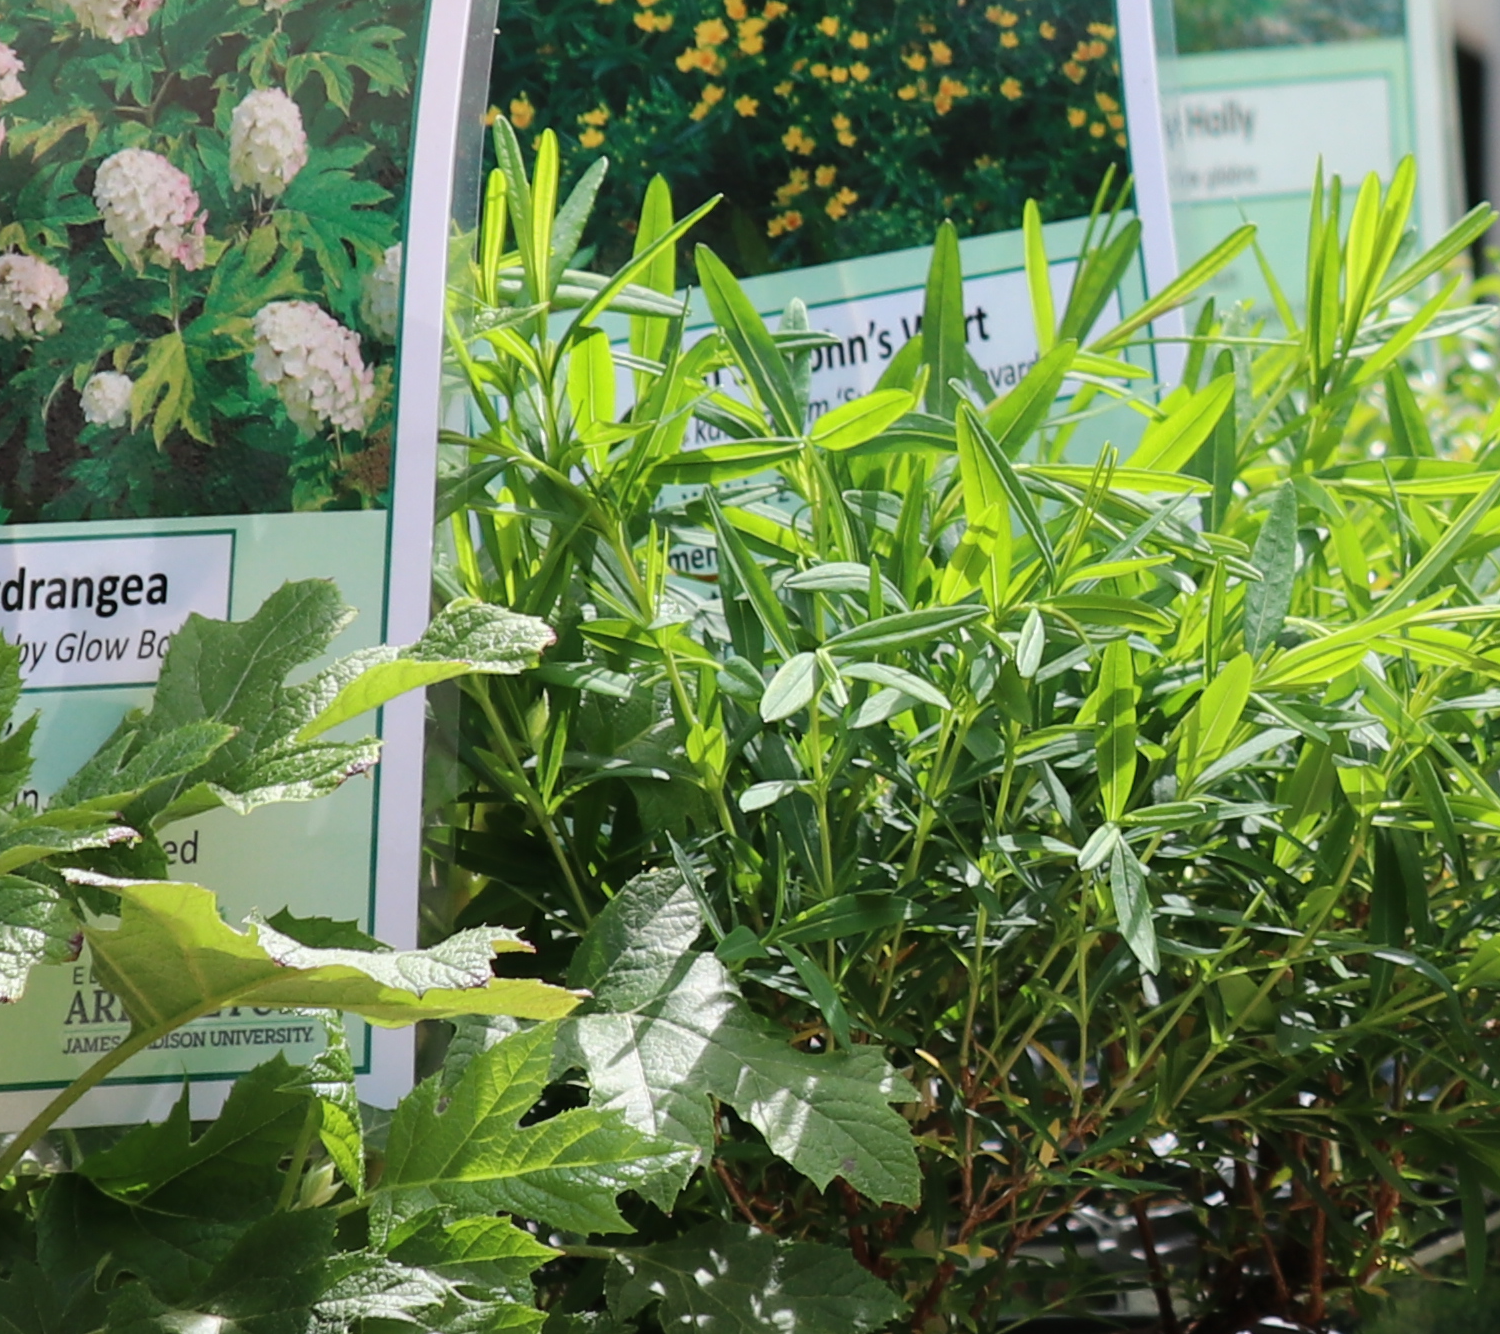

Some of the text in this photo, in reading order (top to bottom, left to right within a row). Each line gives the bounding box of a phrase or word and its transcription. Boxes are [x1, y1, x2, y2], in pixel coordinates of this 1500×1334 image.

[809, 321, 893, 373] ohn's
[55, 630, 129, 664] Glow
[63, 1036, 121, 1054] JAMES
[150, 1032, 206, 1050] DISON
